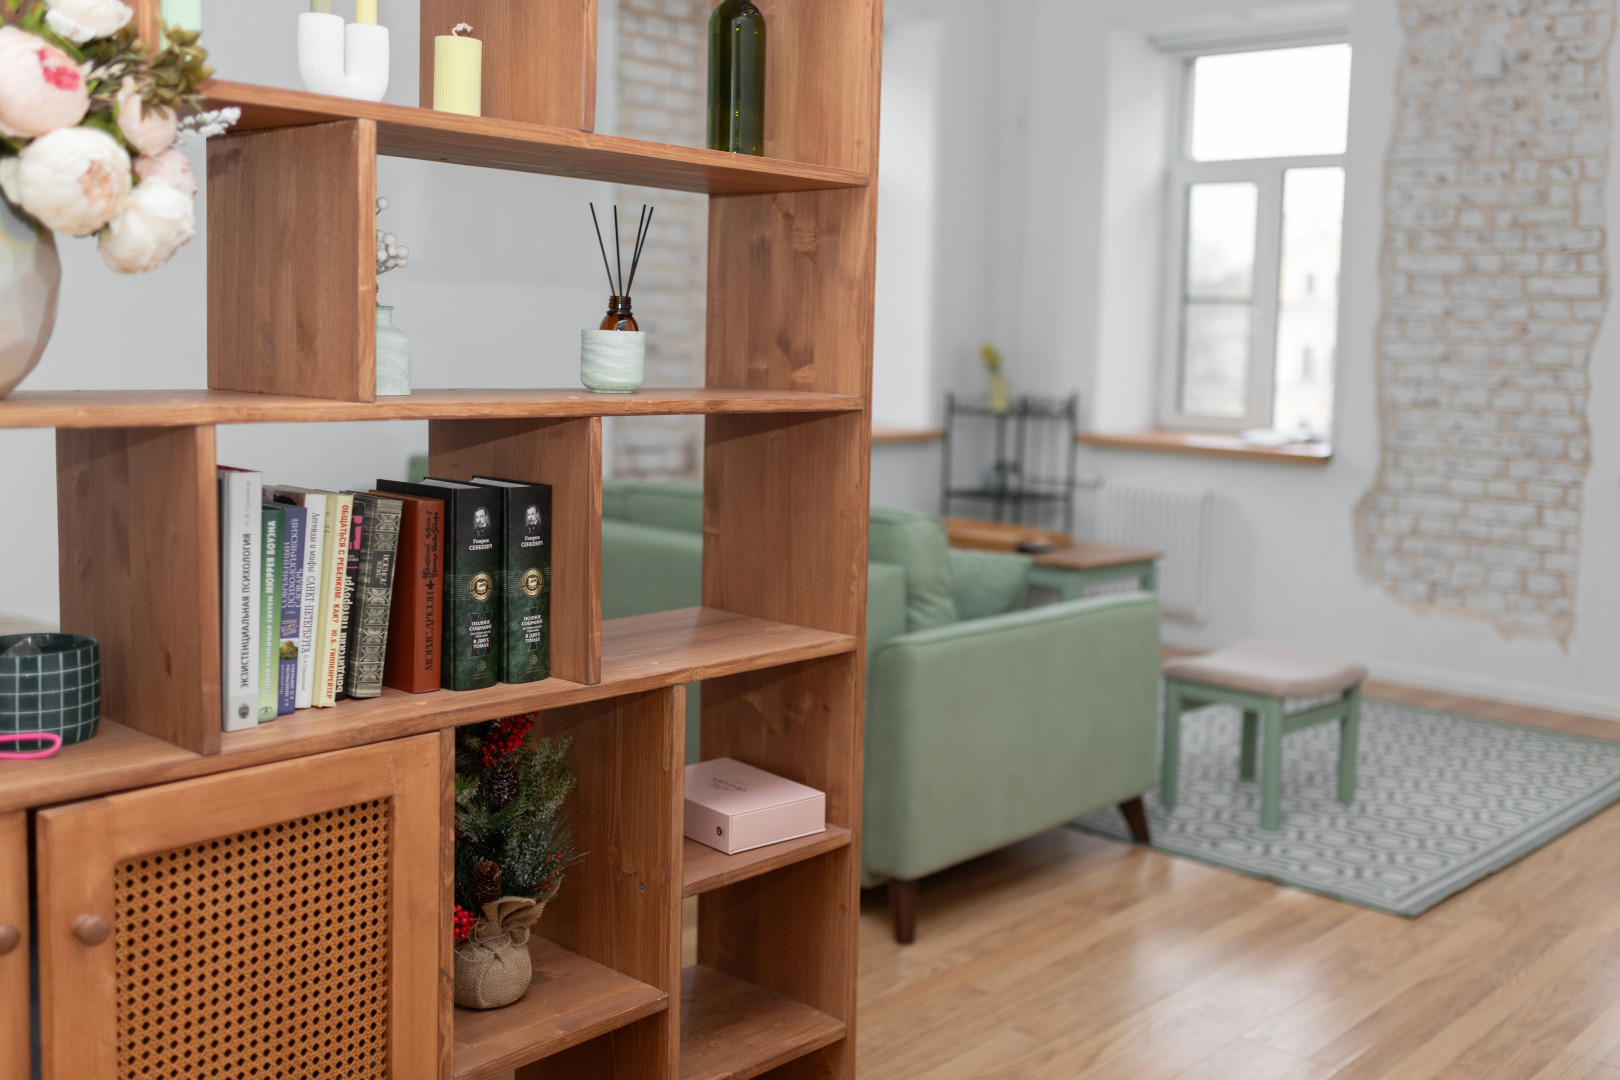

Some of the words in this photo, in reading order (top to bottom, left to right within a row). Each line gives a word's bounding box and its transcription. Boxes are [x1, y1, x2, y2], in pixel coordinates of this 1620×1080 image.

[266, 520, 276, 555] БОУЭНА
[310, 512, 319, 542] Легенды
[339, 505, 349, 547] ОБЩАТЬСЯ
[242, 533, 251, 593] ПСИХОЛОГИЯ
[265, 558, 275, 593] МЮРРЕЯ
[288, 518, 299, 608] ПСИХОЛОГИЧЕСКИЙ
[307, 551, 317, 572] мифы
[334, 558, 344, 601] РЕБЕНКОМ.
[380, 555, 390, 586] ЛОНДОН
[294, 569, 303, 608] СЛОВАРЬ
[301, 576, 316, 653] САНКТ-ПЕТЕРБУРГА
[332, 604, 340, 623] КАК?
[426, 592, 435, 631] ДРЮОН
[240, 596, 251, 688] ЭКЗИСТЕНЦИАЛЬНАЯ
[265, 625, 273, 666] семейных
[425, 632, 434, 671] МОРИС
[262, 668, 272, 697] Теория
[327, 648, 336, 699] ГИППЕНРЕЙТЕР
